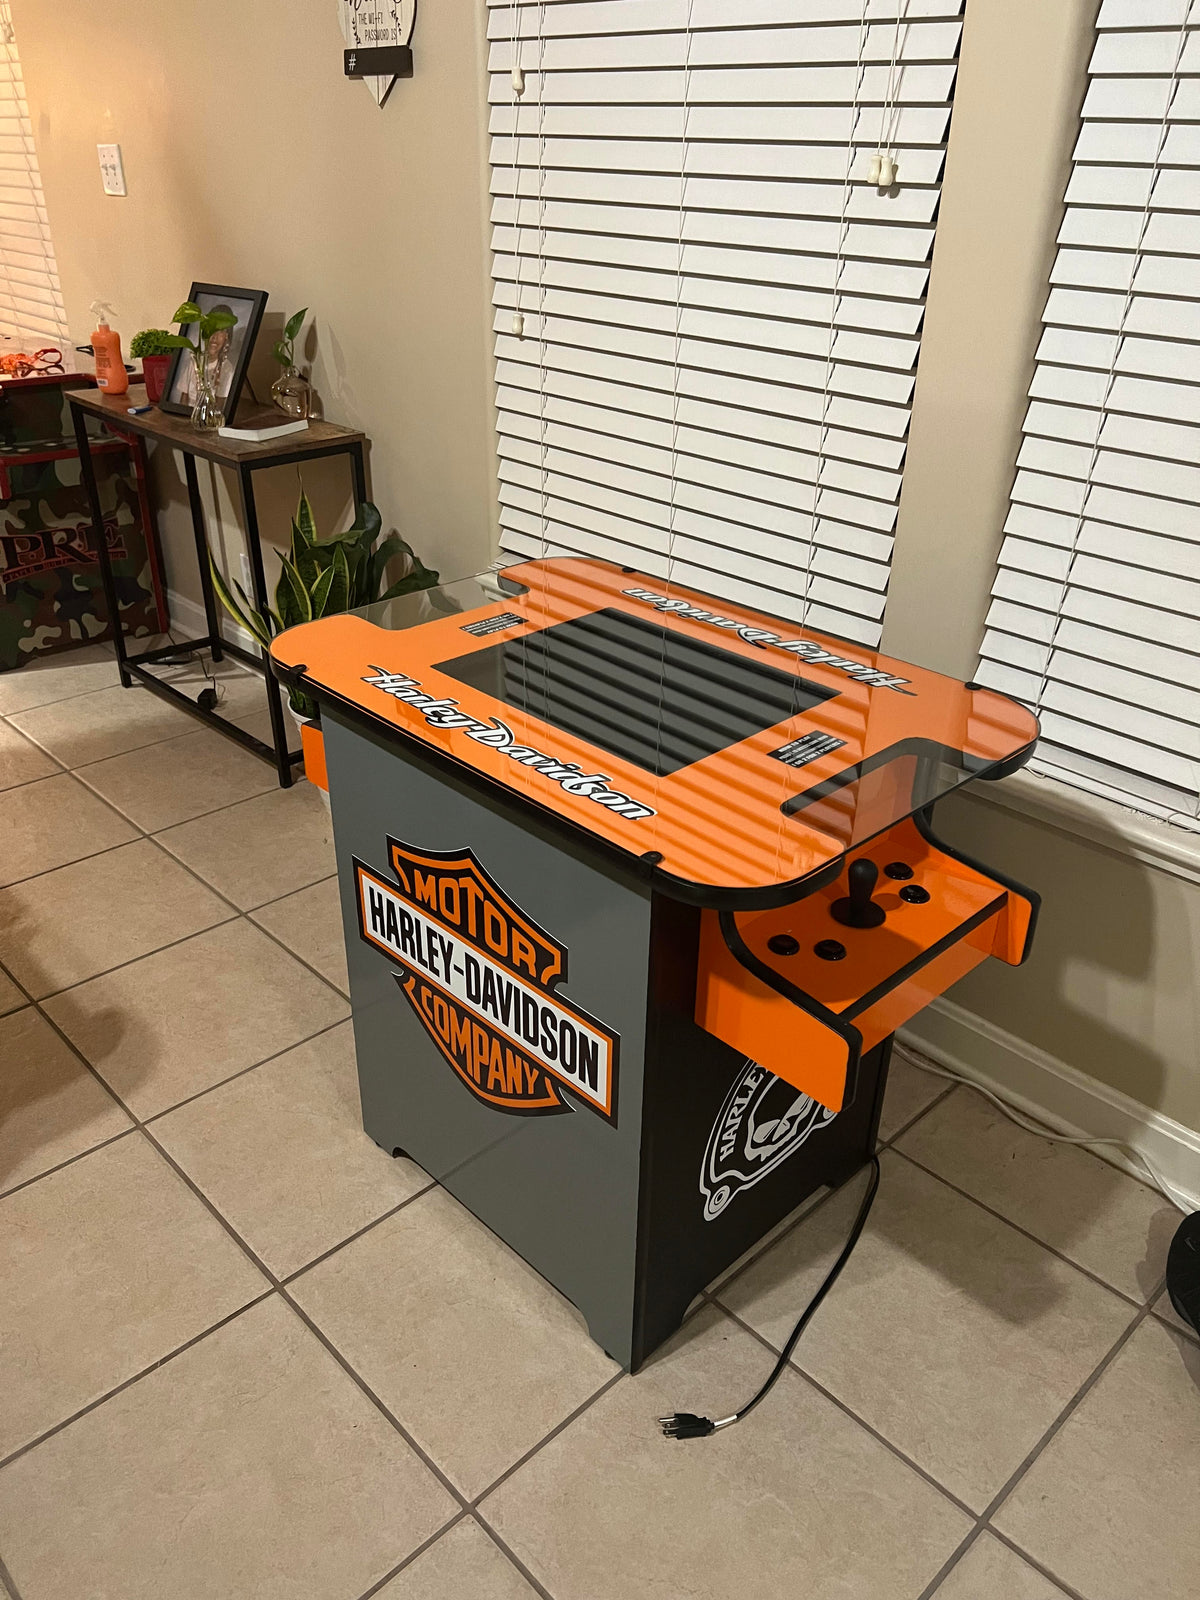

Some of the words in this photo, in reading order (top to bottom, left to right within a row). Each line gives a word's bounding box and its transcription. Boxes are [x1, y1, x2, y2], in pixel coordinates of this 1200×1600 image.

[358, 13, 367, 25] THE
[364, 28, 389, 41] PASSWORD
[390, 28, 397, 40] IS
[413, 868, 537, 978] MOTOR
[368, 885, 599, 1093] HARLEY-DAVIDSON
[420, 985, 540, 1095] COMPANY
